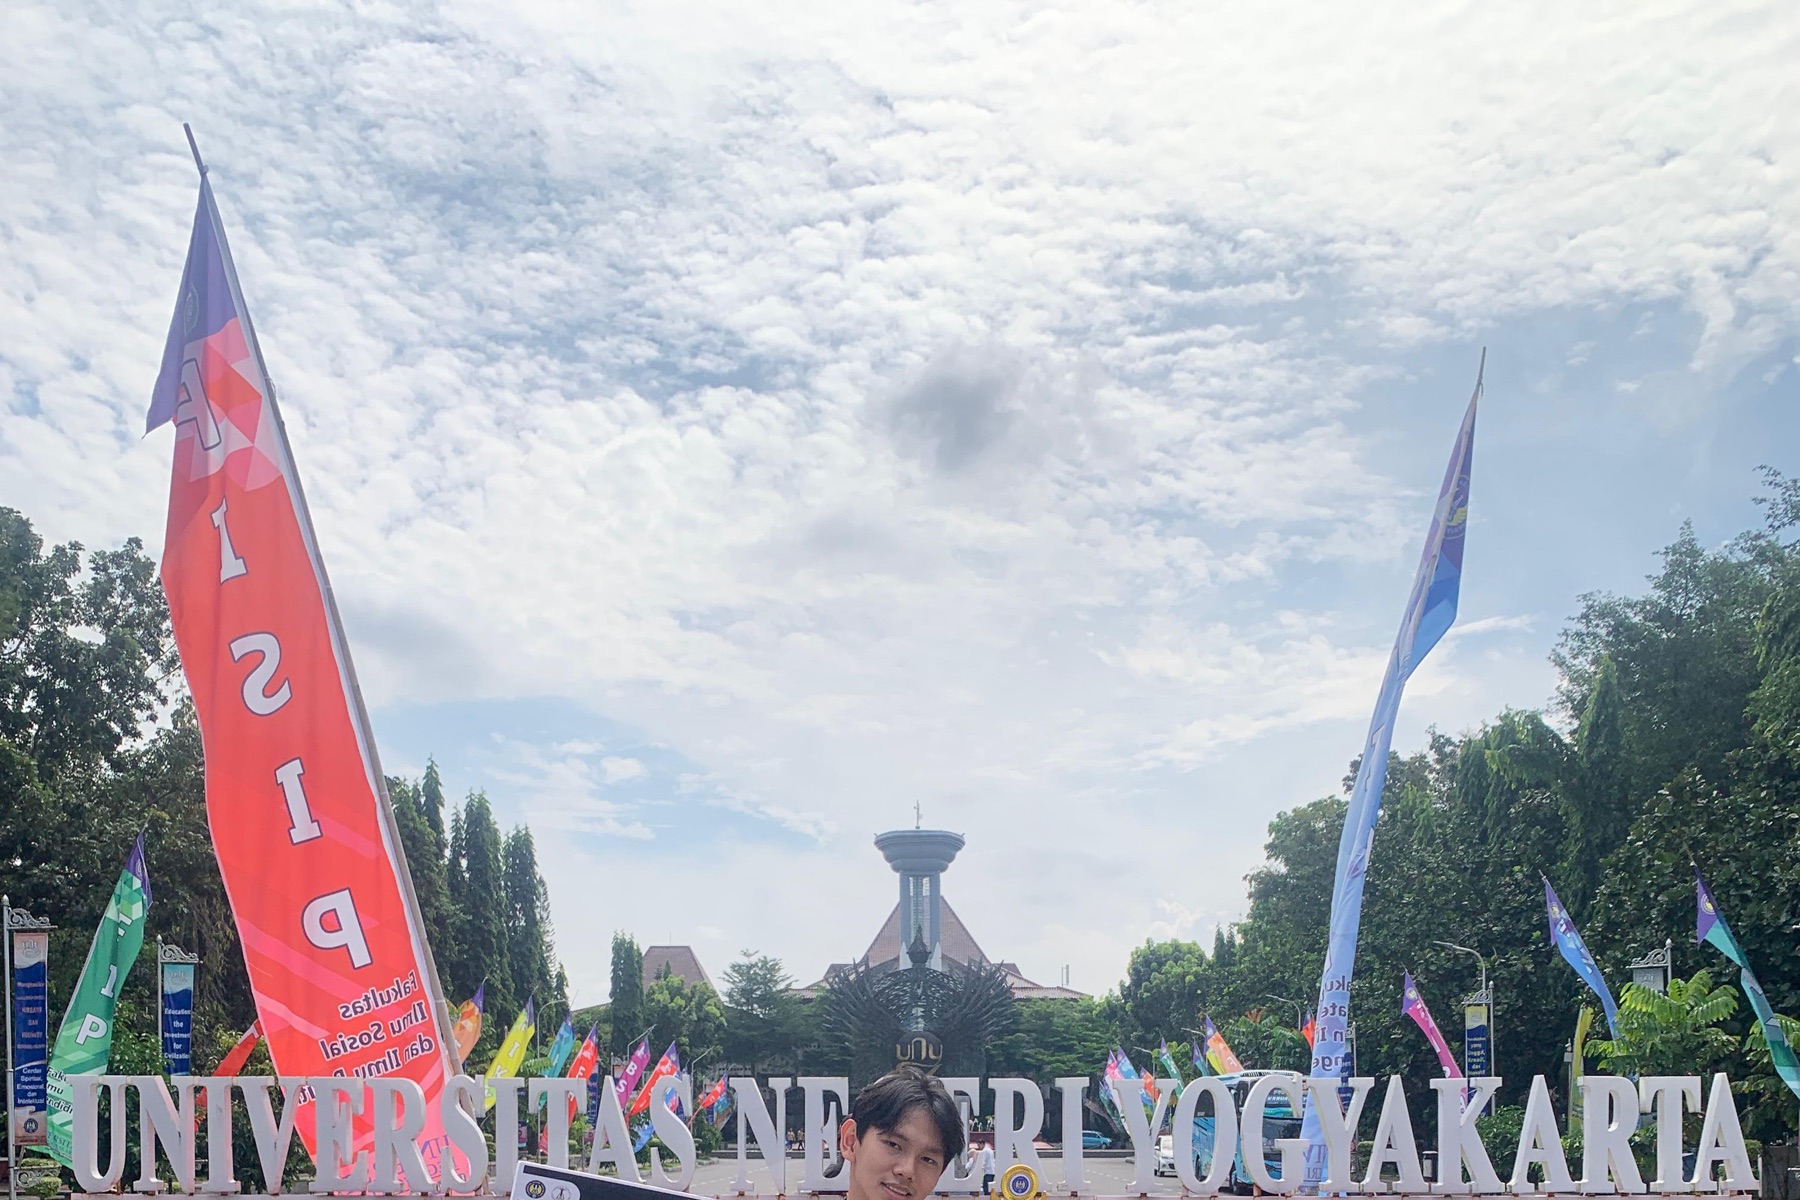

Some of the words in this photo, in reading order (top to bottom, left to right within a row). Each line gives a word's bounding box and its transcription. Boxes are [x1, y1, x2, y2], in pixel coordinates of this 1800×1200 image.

[66, 1073, 698, 1194] UNIVERSITAS
[728, 1076, 1091, 1193] NEERI
[1111, 1072, 1761, 1195] YOGYAKARTA
